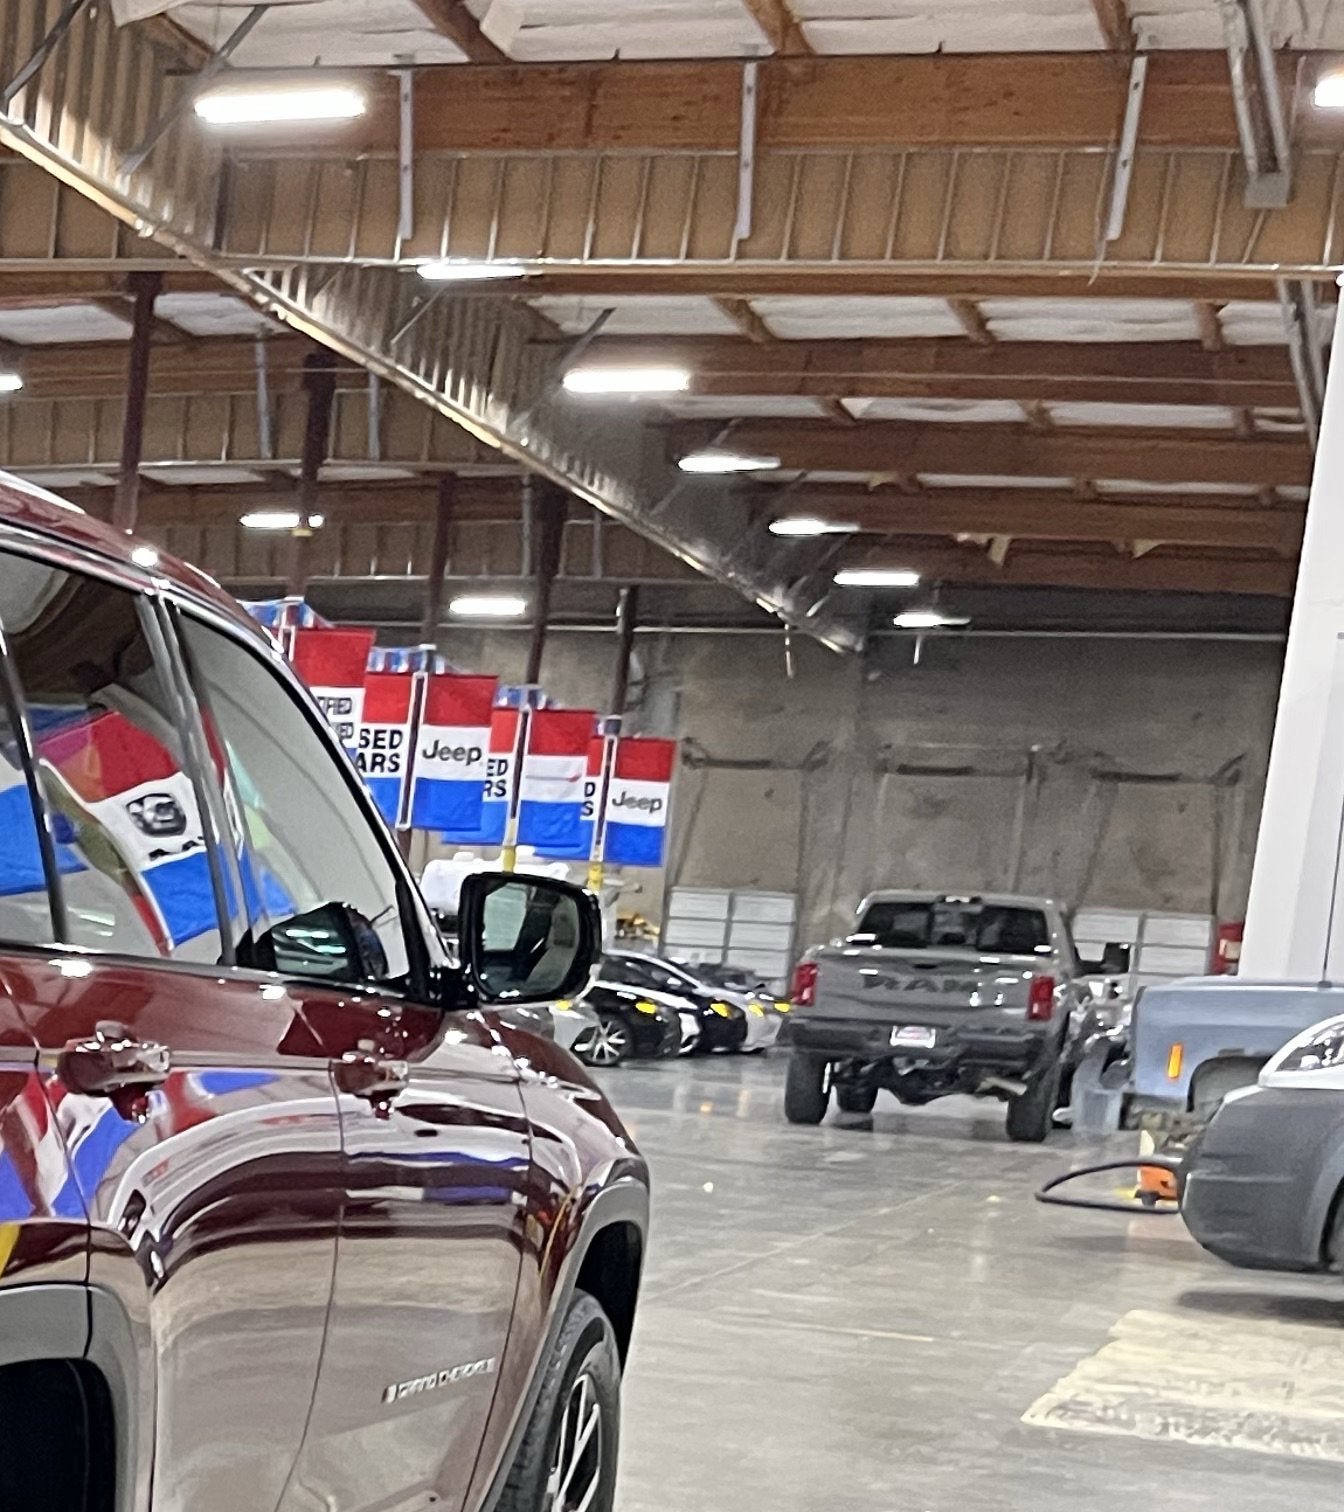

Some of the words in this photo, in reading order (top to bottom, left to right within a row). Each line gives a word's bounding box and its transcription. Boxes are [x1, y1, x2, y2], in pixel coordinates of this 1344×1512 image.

[358, 728, 404, 750] SED
[356, 752, 401, 773] ARS
[422, 739, 482, 766] Jeep
[612, 791, 662, 814] Jeep
